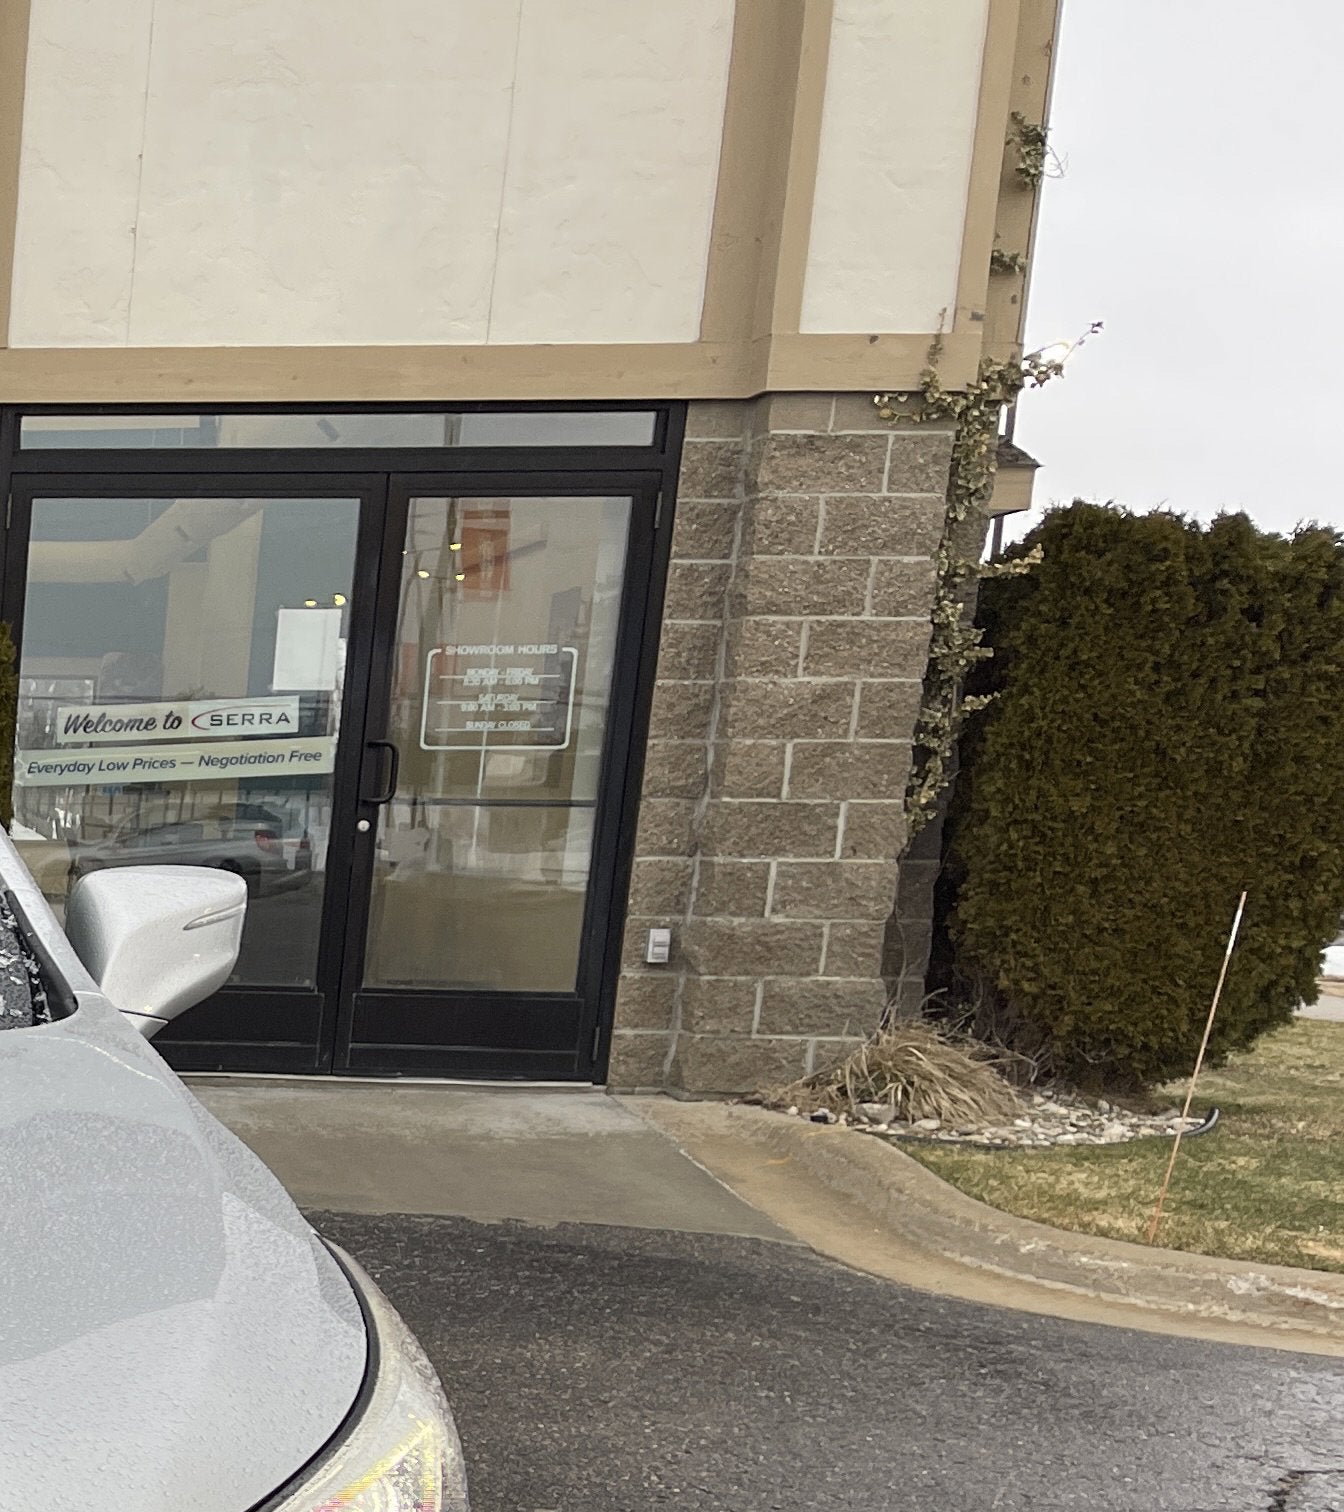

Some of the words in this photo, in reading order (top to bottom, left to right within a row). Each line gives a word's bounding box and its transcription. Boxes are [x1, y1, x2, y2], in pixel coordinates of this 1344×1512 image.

[445, 645, 514, 655] SHOWROOM
[518, 644, 558, 654] HOURS
[64, 712, 157, 735] Welcome
[163, 710, 182, 730] to
[210, 712, 291, 727] SERRA
[27, 761, 96, 776] Everyday
[98, 759, 129, 771] Low
[132, 757, 177, 770] Prices
[198, 751, 285, 769] Negotiation
[288, 750, 323, 763] Free
